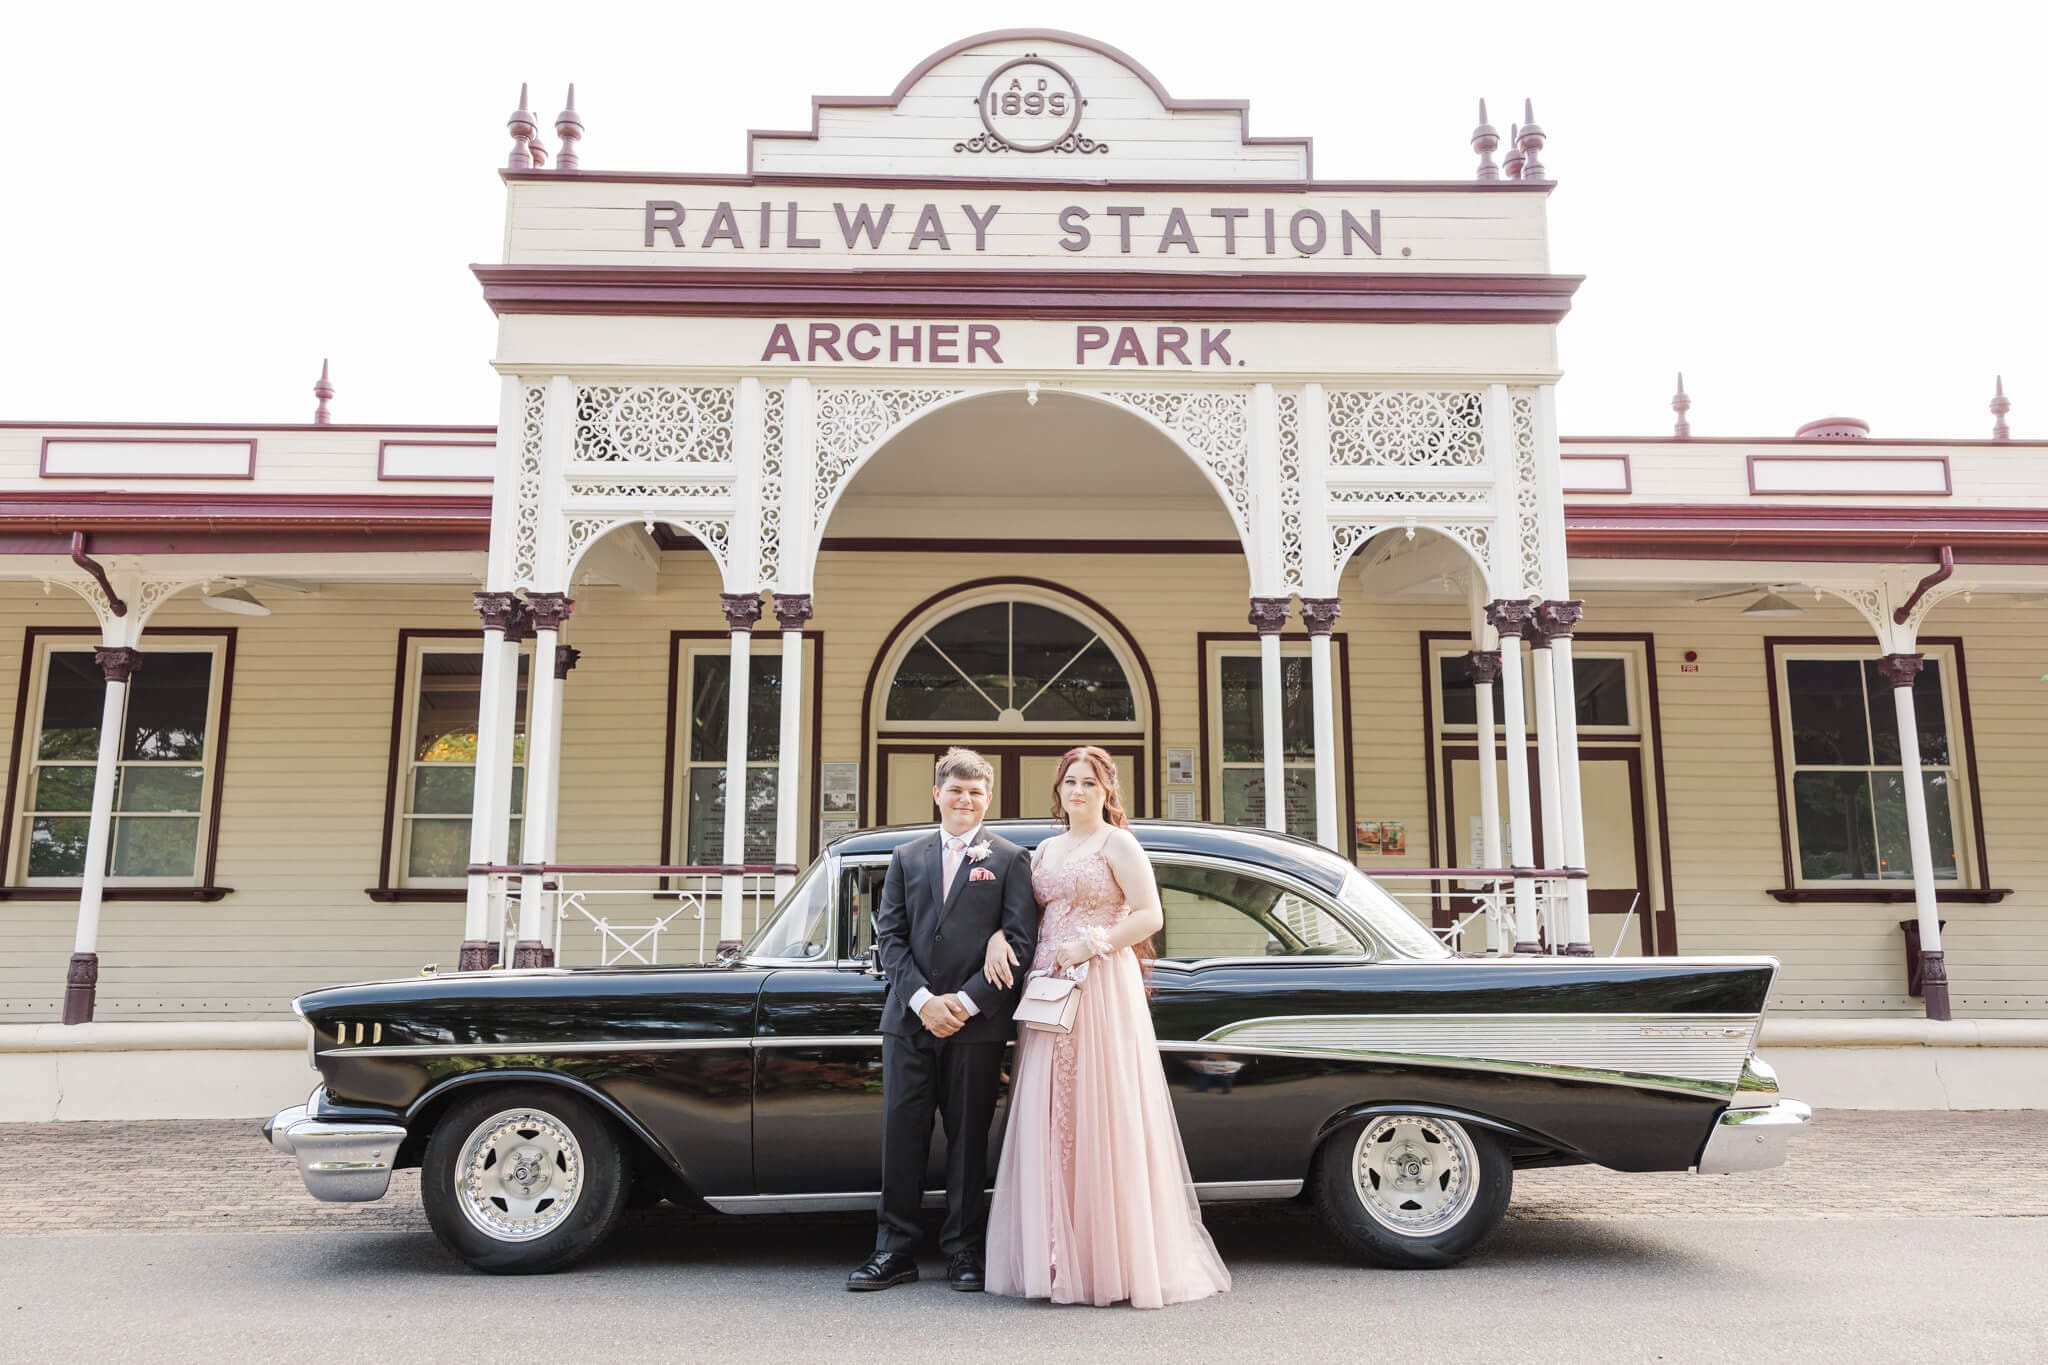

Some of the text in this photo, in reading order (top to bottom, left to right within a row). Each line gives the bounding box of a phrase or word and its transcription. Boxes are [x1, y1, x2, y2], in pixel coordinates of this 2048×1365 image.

[1009, 78, 1048, 91] A D
[644, 200, 1413, 258] RAILWAY STATION.
[760, 322, 1246, 367] ARCHER PARK.
